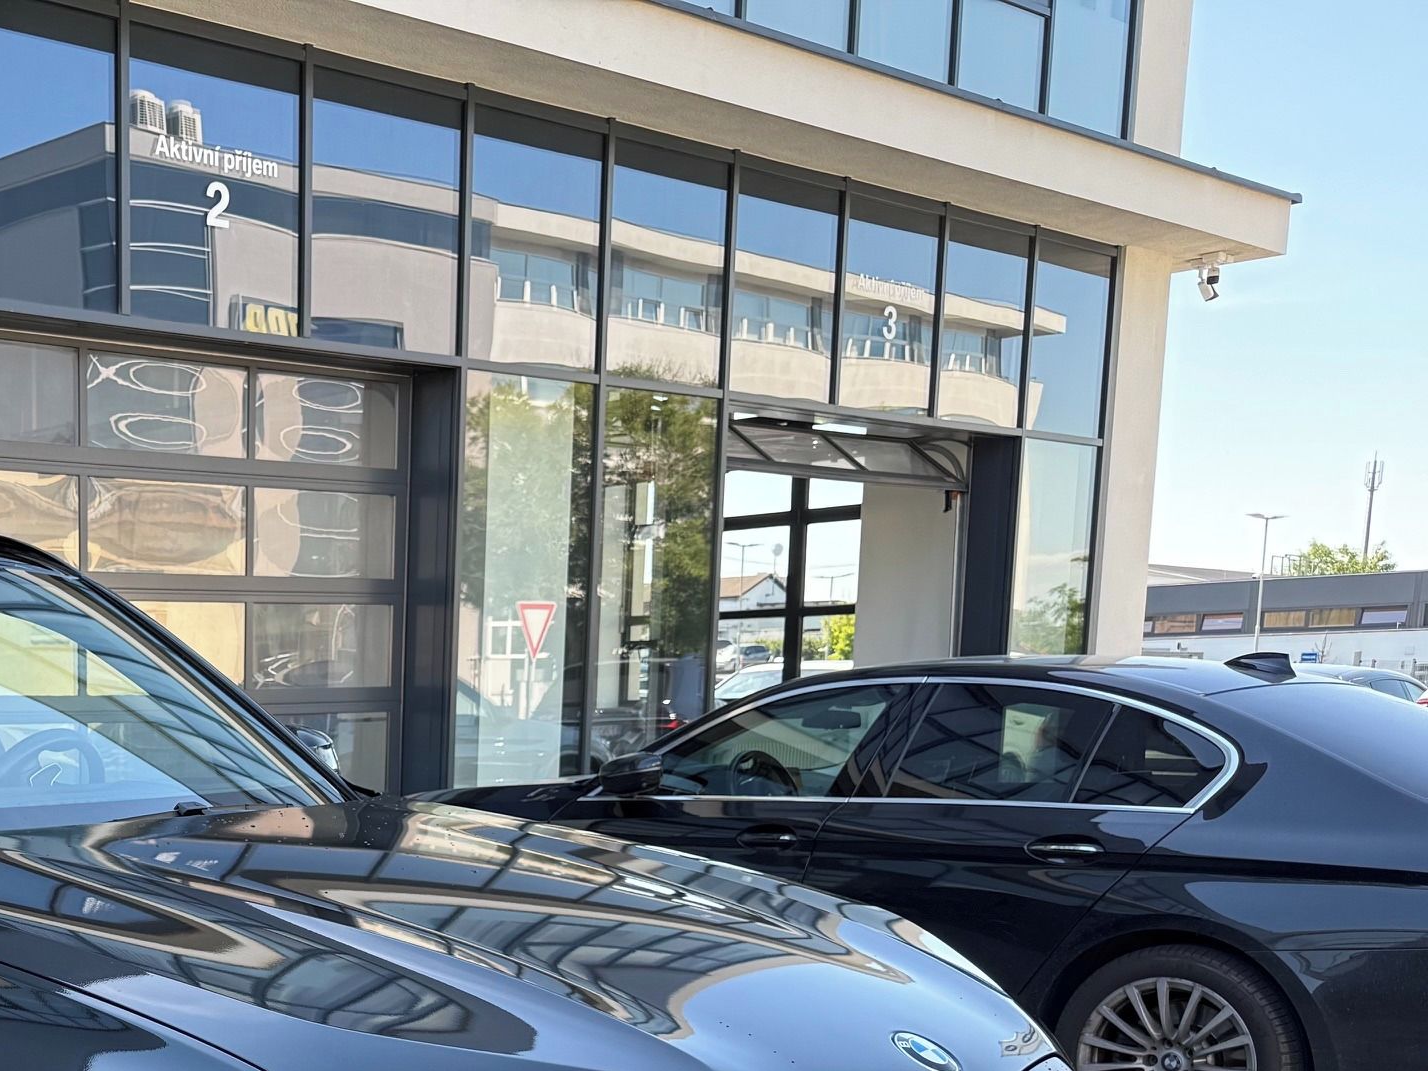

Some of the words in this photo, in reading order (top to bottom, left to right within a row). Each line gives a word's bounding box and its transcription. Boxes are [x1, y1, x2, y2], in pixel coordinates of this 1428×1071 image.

[155, 134, 221, 167] Aktivní
[223, 149, 278, 178] příjem
[206, 181, 230, 229] 2
[882, 305, 897, 340] 3
